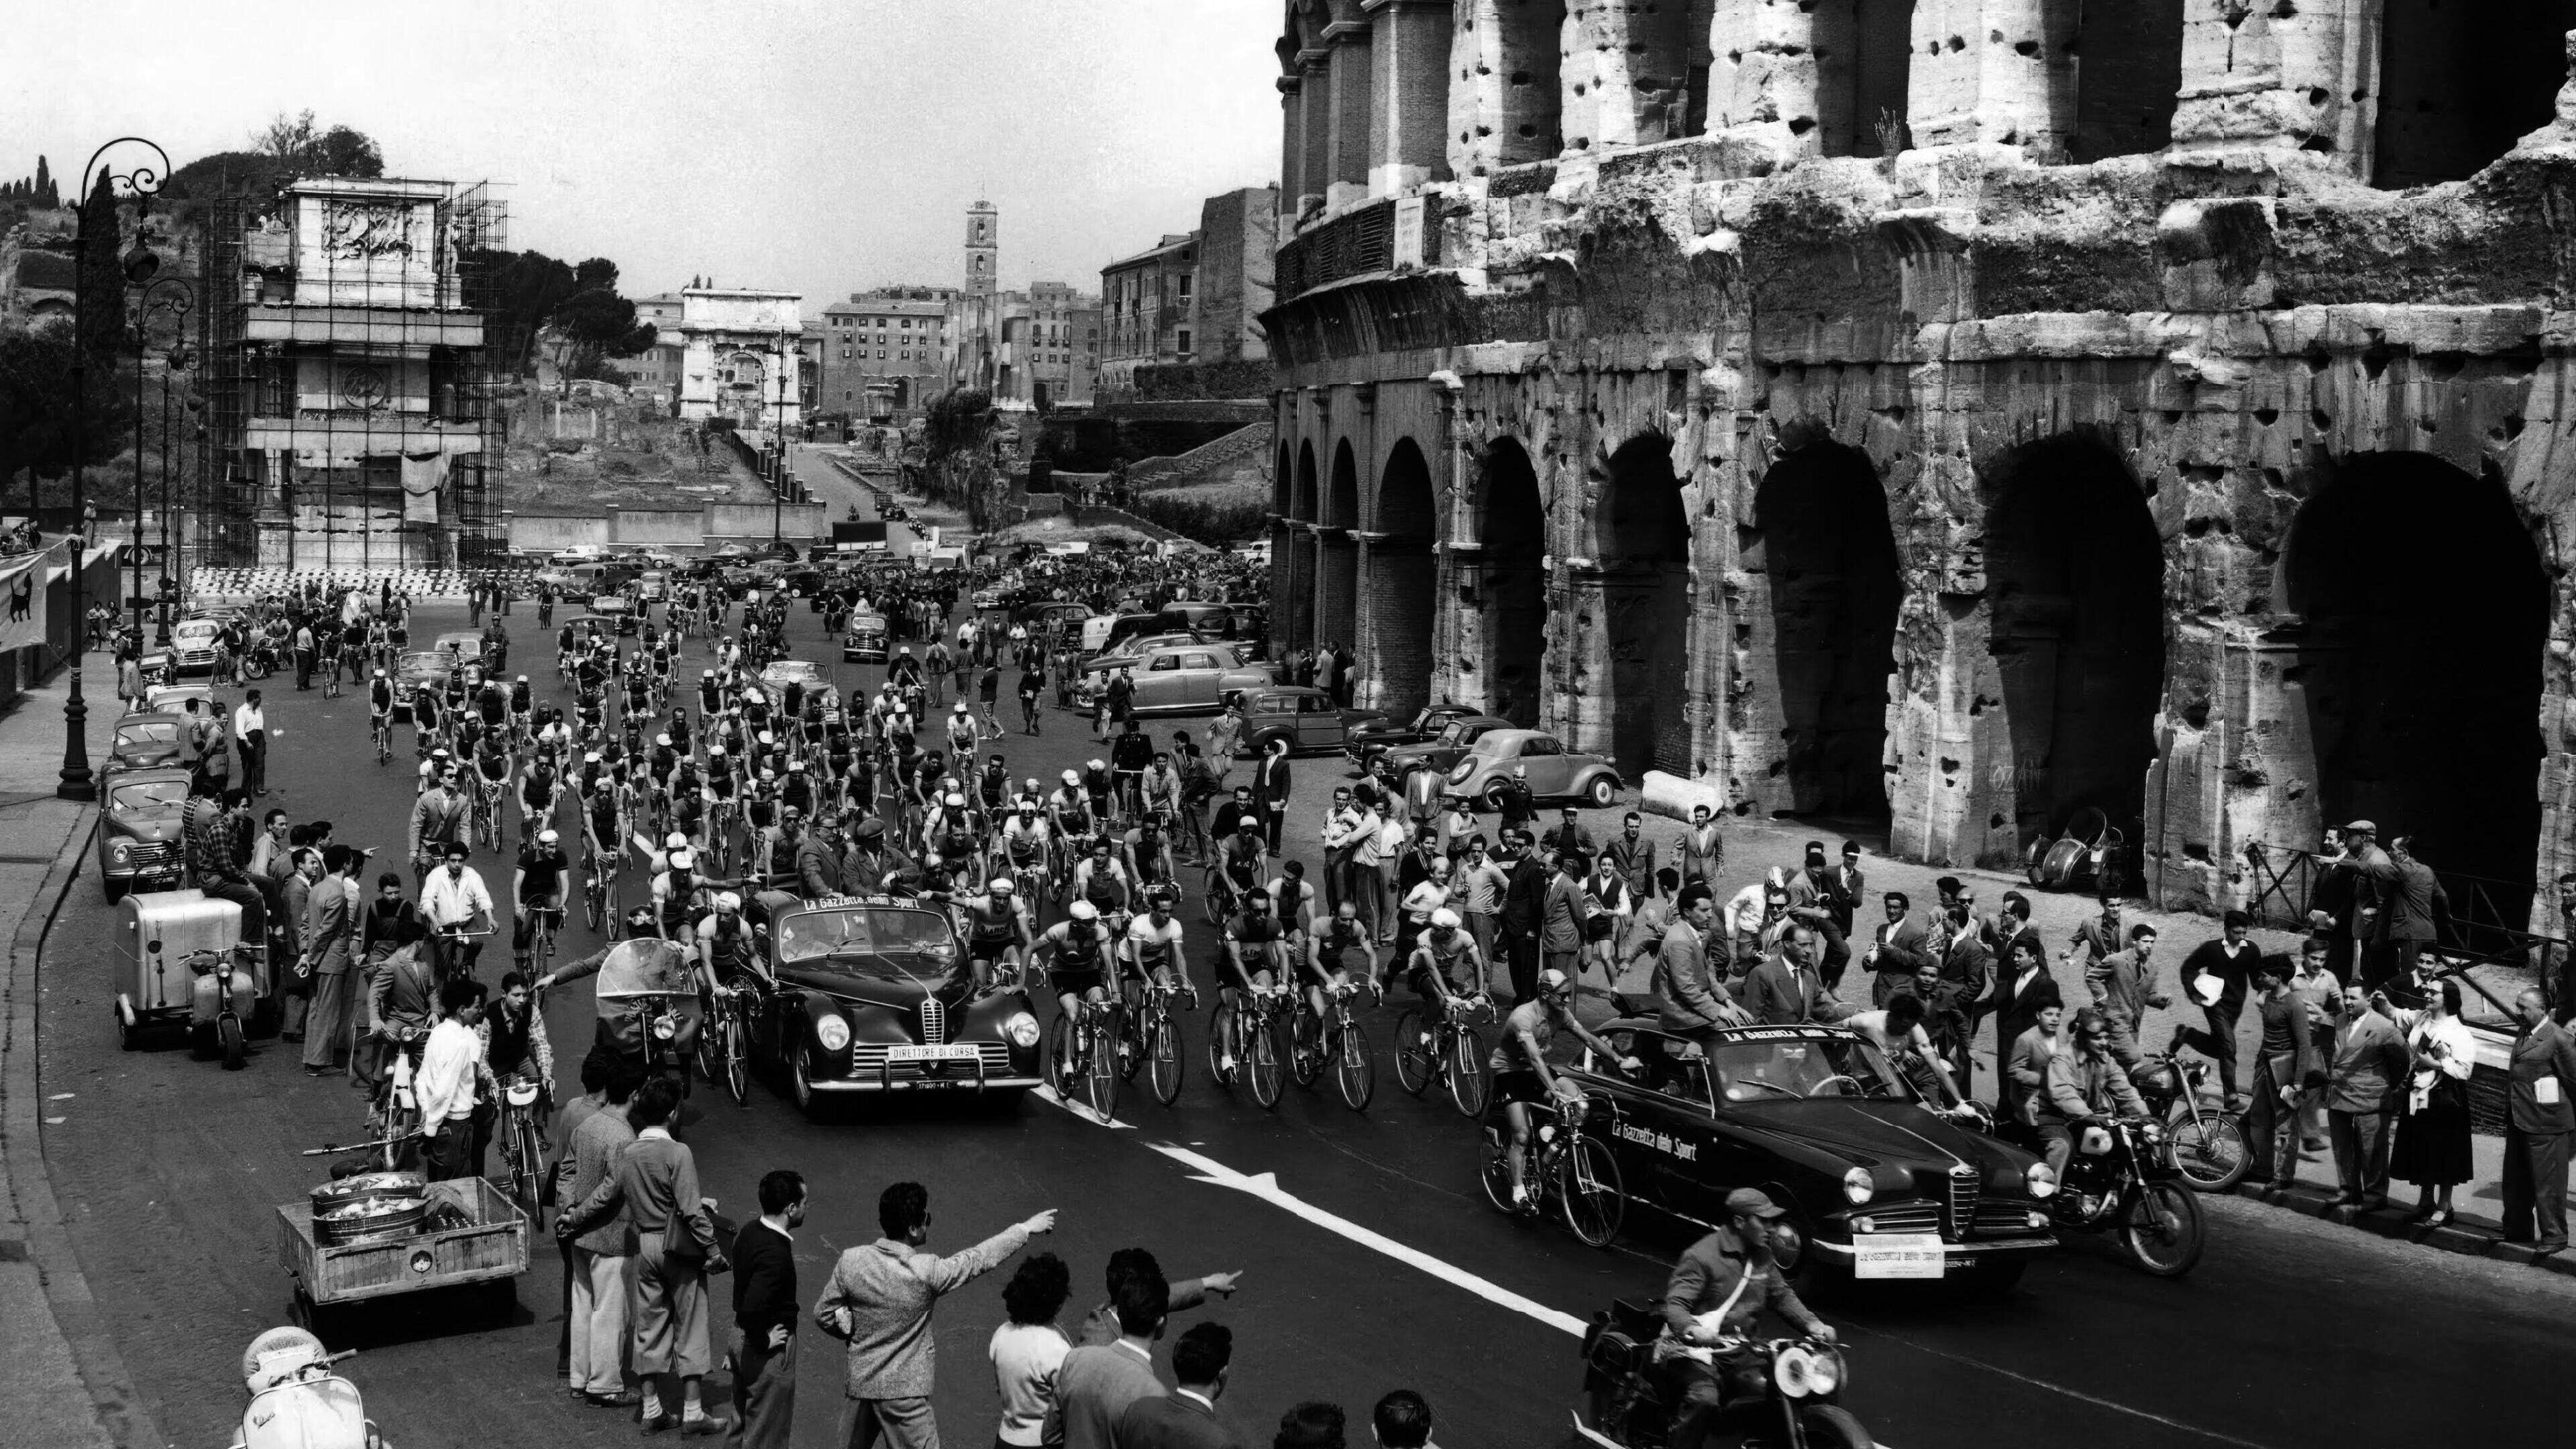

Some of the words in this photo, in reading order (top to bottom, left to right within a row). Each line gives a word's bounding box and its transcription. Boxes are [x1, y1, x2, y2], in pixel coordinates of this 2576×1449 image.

[894, 1047, 935, 1058] DIRETTORE
[938, 1048, 946, 1057] DI
[949, 1046, 975, 1057] CORSA
[1613, 1120, 1621, 1136] La
[1674, 1138, 1697, 1162] Sport
